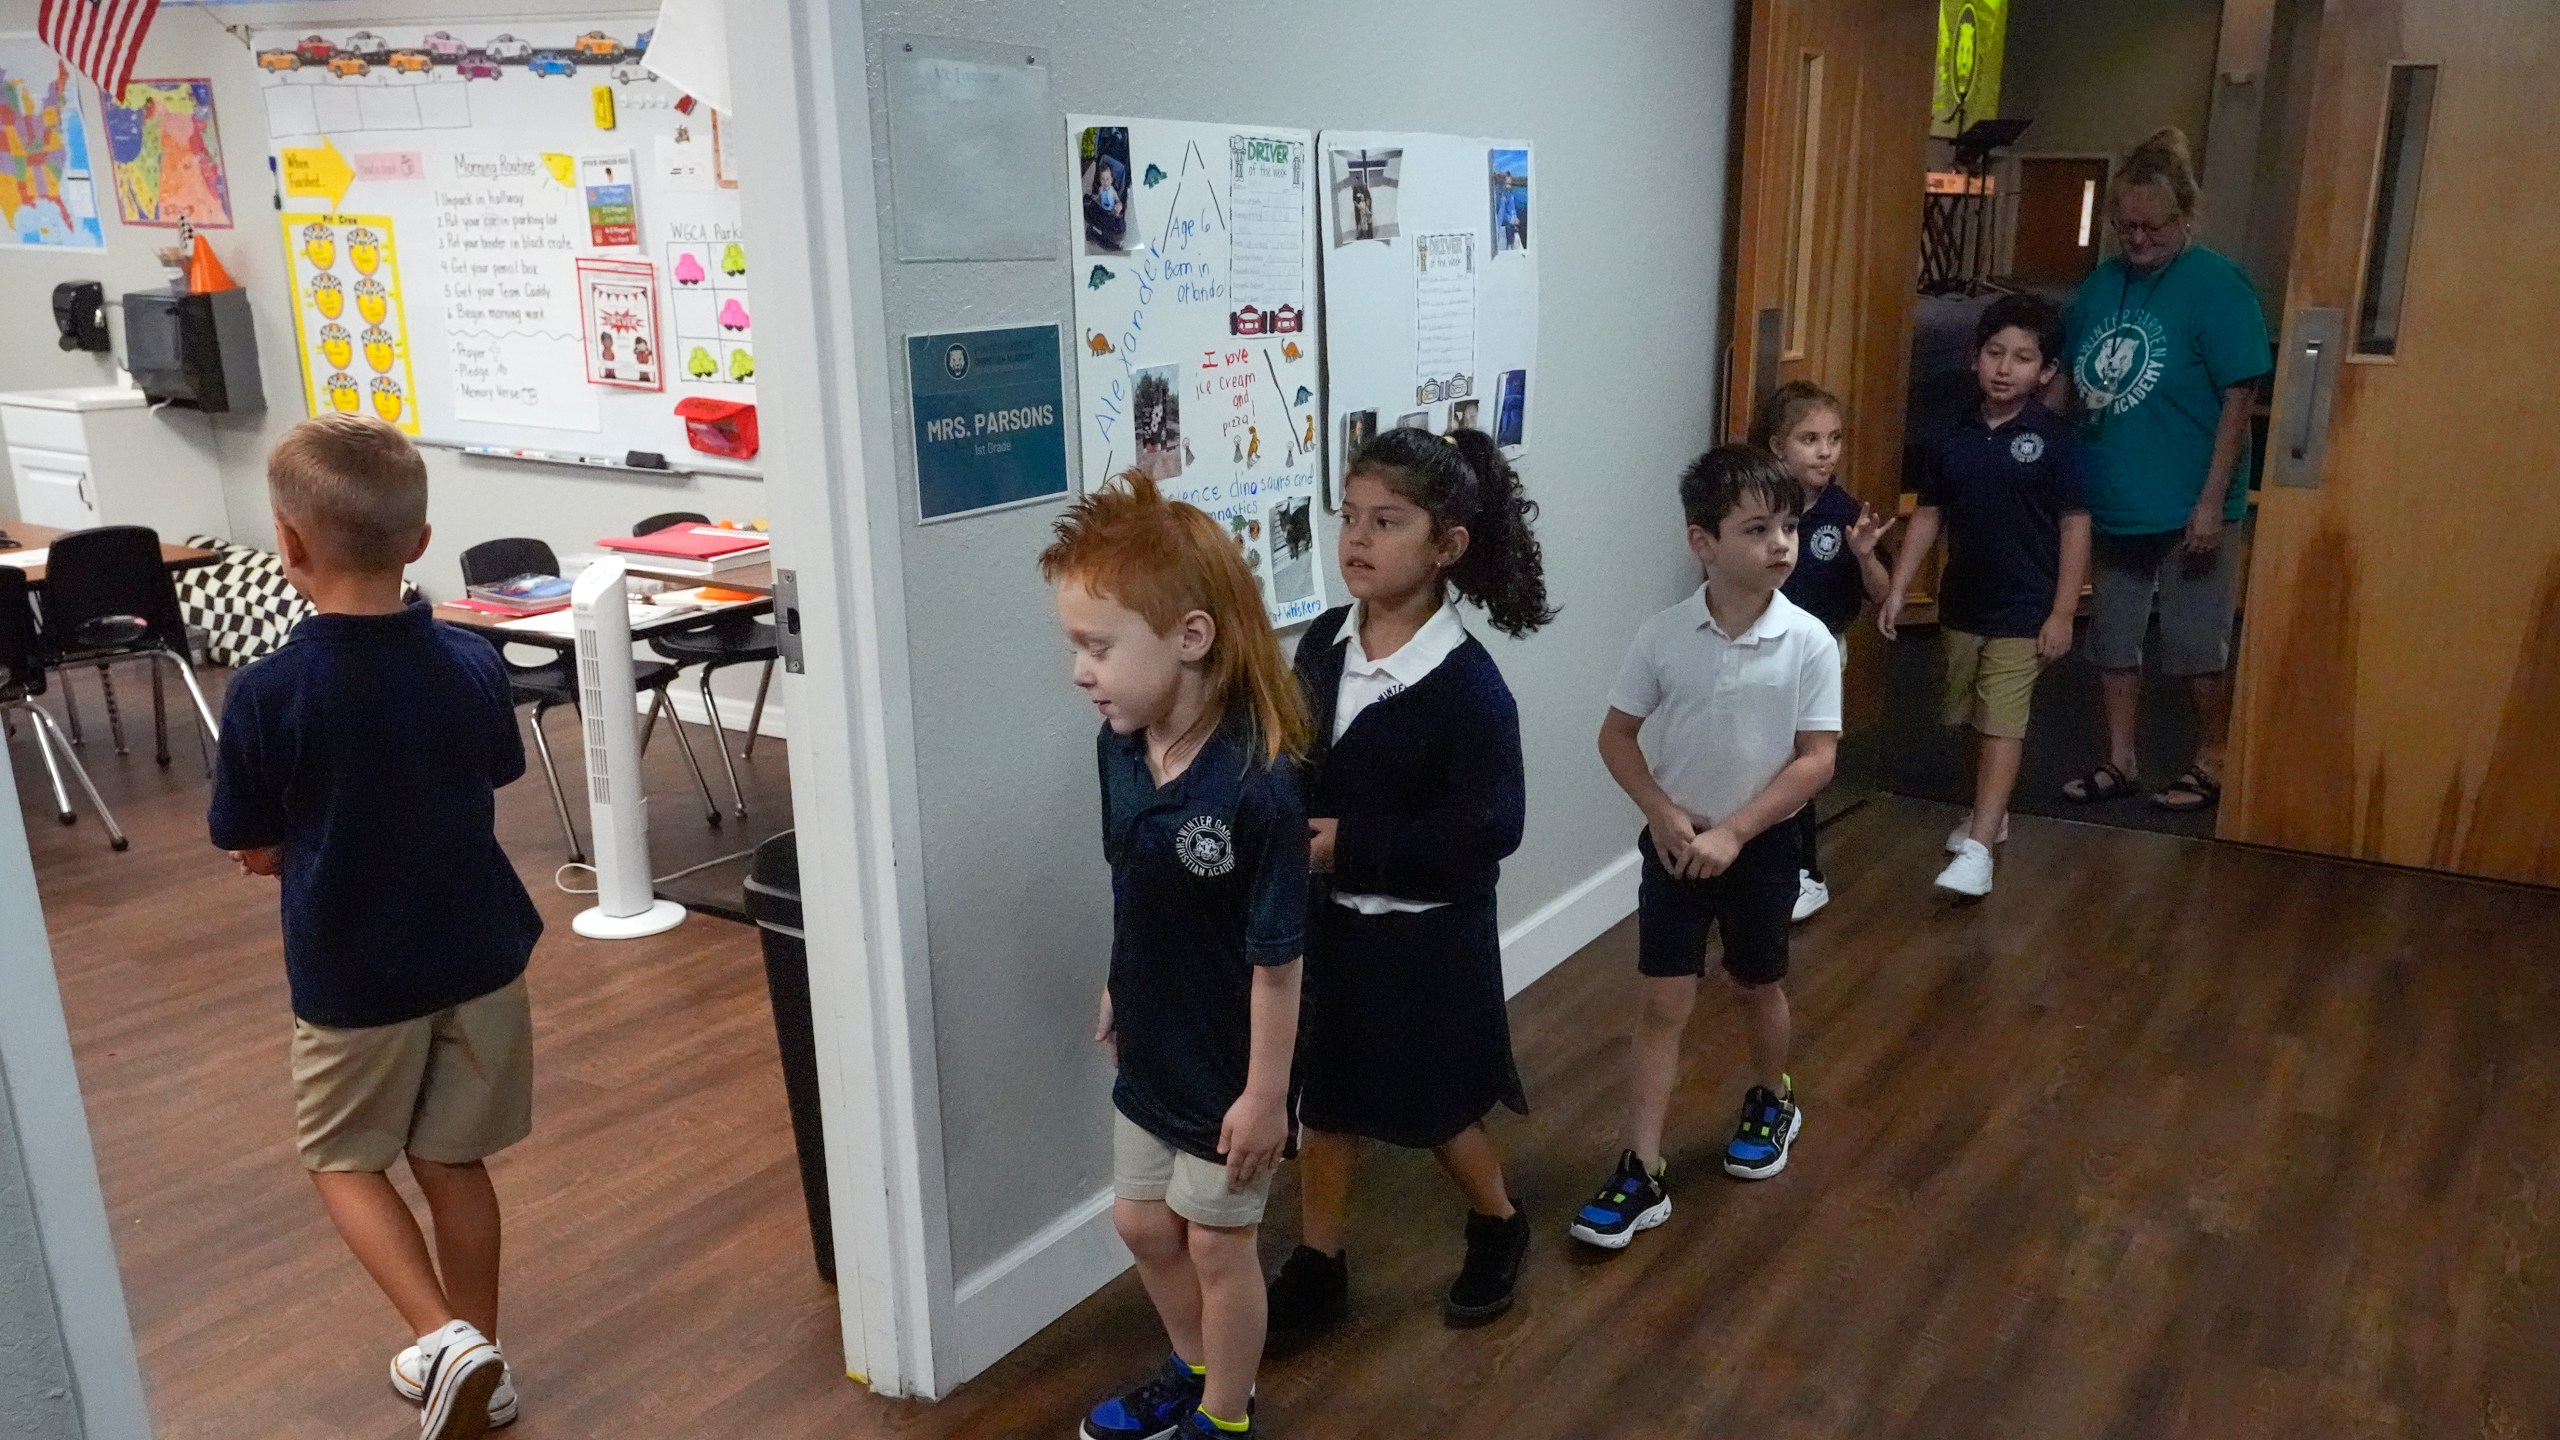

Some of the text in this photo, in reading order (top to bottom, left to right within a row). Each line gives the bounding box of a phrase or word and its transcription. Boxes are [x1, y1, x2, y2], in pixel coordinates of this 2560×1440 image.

[1247, 141, 1289, 164] DRIVER
[455, 153, 536, 180] Morning Routine
[1248, 161, 1257, 177] of
[1260, 163, 1271, 178] the
[442, 192, 473, 208] Unpack
[476, 194, 486, 204] in
[488, 189, 524, 207] hallway
[444, 212, 459, 226] Put
[463, 217, 480, 232] your
[512, 212, 545, 231] parking
[546, 213, 558, 225] lot
[669, 222, 708, 241] WGCA
[1170, 207, 1211, 250] Age 6
[447, 231, 460, 247] Put
[463, 238, 478, 251] your
[510, 238, 520, 249] in
[521, 234, 545, 250] black
[547, 234, 573, 250] crate
[1429, 237, 1463, 255] DRIVER
[451, 257, 467, 274] Get
[470, 263, 489, 278] your
[521, 259, 539, 275] box
[1164, 252, 1210, 281] Born in
[454, 282, 471, 298] Get
[477, 286, 495, 301] your
[498, 282, 521, 298] Team
[524, 282, 551, 299] Caddy
[456, 303, 486, 324] Begin
[488, 308, 522, 324] morning
[525, 307, 545, 319] work
[1095, 236, 1160, 444] Alexander
[456, 342, 485, 363] Prayer
[1202, 348, 1249, 369] I love
[459, 362, 489, 382] Pledge
[461, 383, 521, 401] Memory Verse
[1195, 371, 1256, 401] ice cream
[2113, 360, 2165, 415] ACADEMY
[1232, 388, 1249, 411] and
[927, 404, 1054, 443] MRS. PARSONS
[974, 440, 1012, 456] 1st Grade
[1294, 464, 1315, 486] and
[1207, 500, 1259, 522] mnastics
[1283, 599, 1321, 620] Whiskers
[1377, 683, 1405, 702] WINTE
[1177, 815, 1213, 837] WINTER
[1175, 836, 1206, 877] CHRISTIAN
